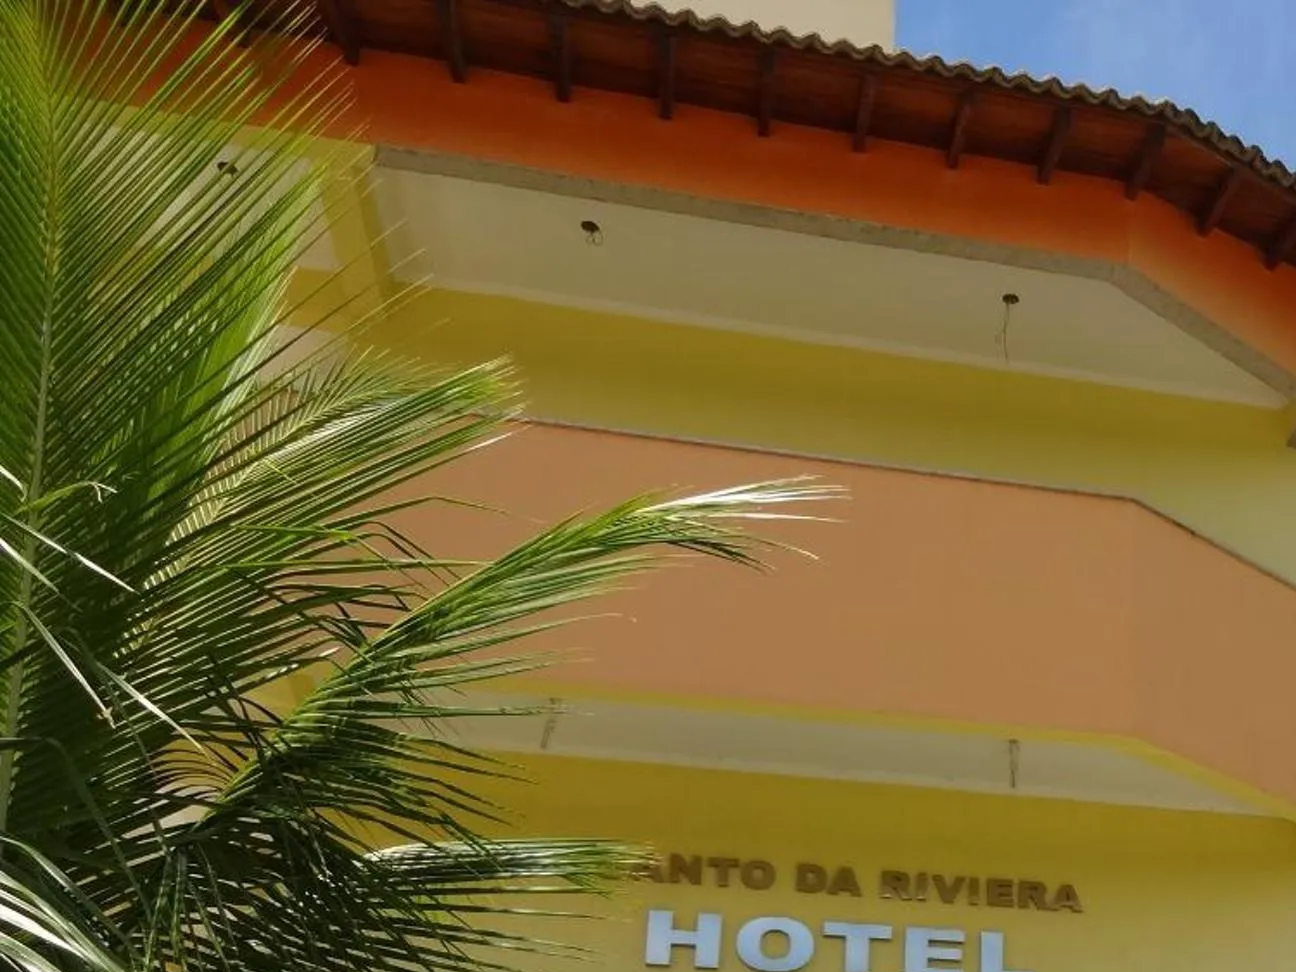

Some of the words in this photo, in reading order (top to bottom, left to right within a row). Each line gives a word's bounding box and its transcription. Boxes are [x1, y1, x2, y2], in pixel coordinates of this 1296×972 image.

[622, 853, 776, 891] ANTO
[795, 863, 863, 898] DA
[879, 870, 1084, 914] RIVIERA
